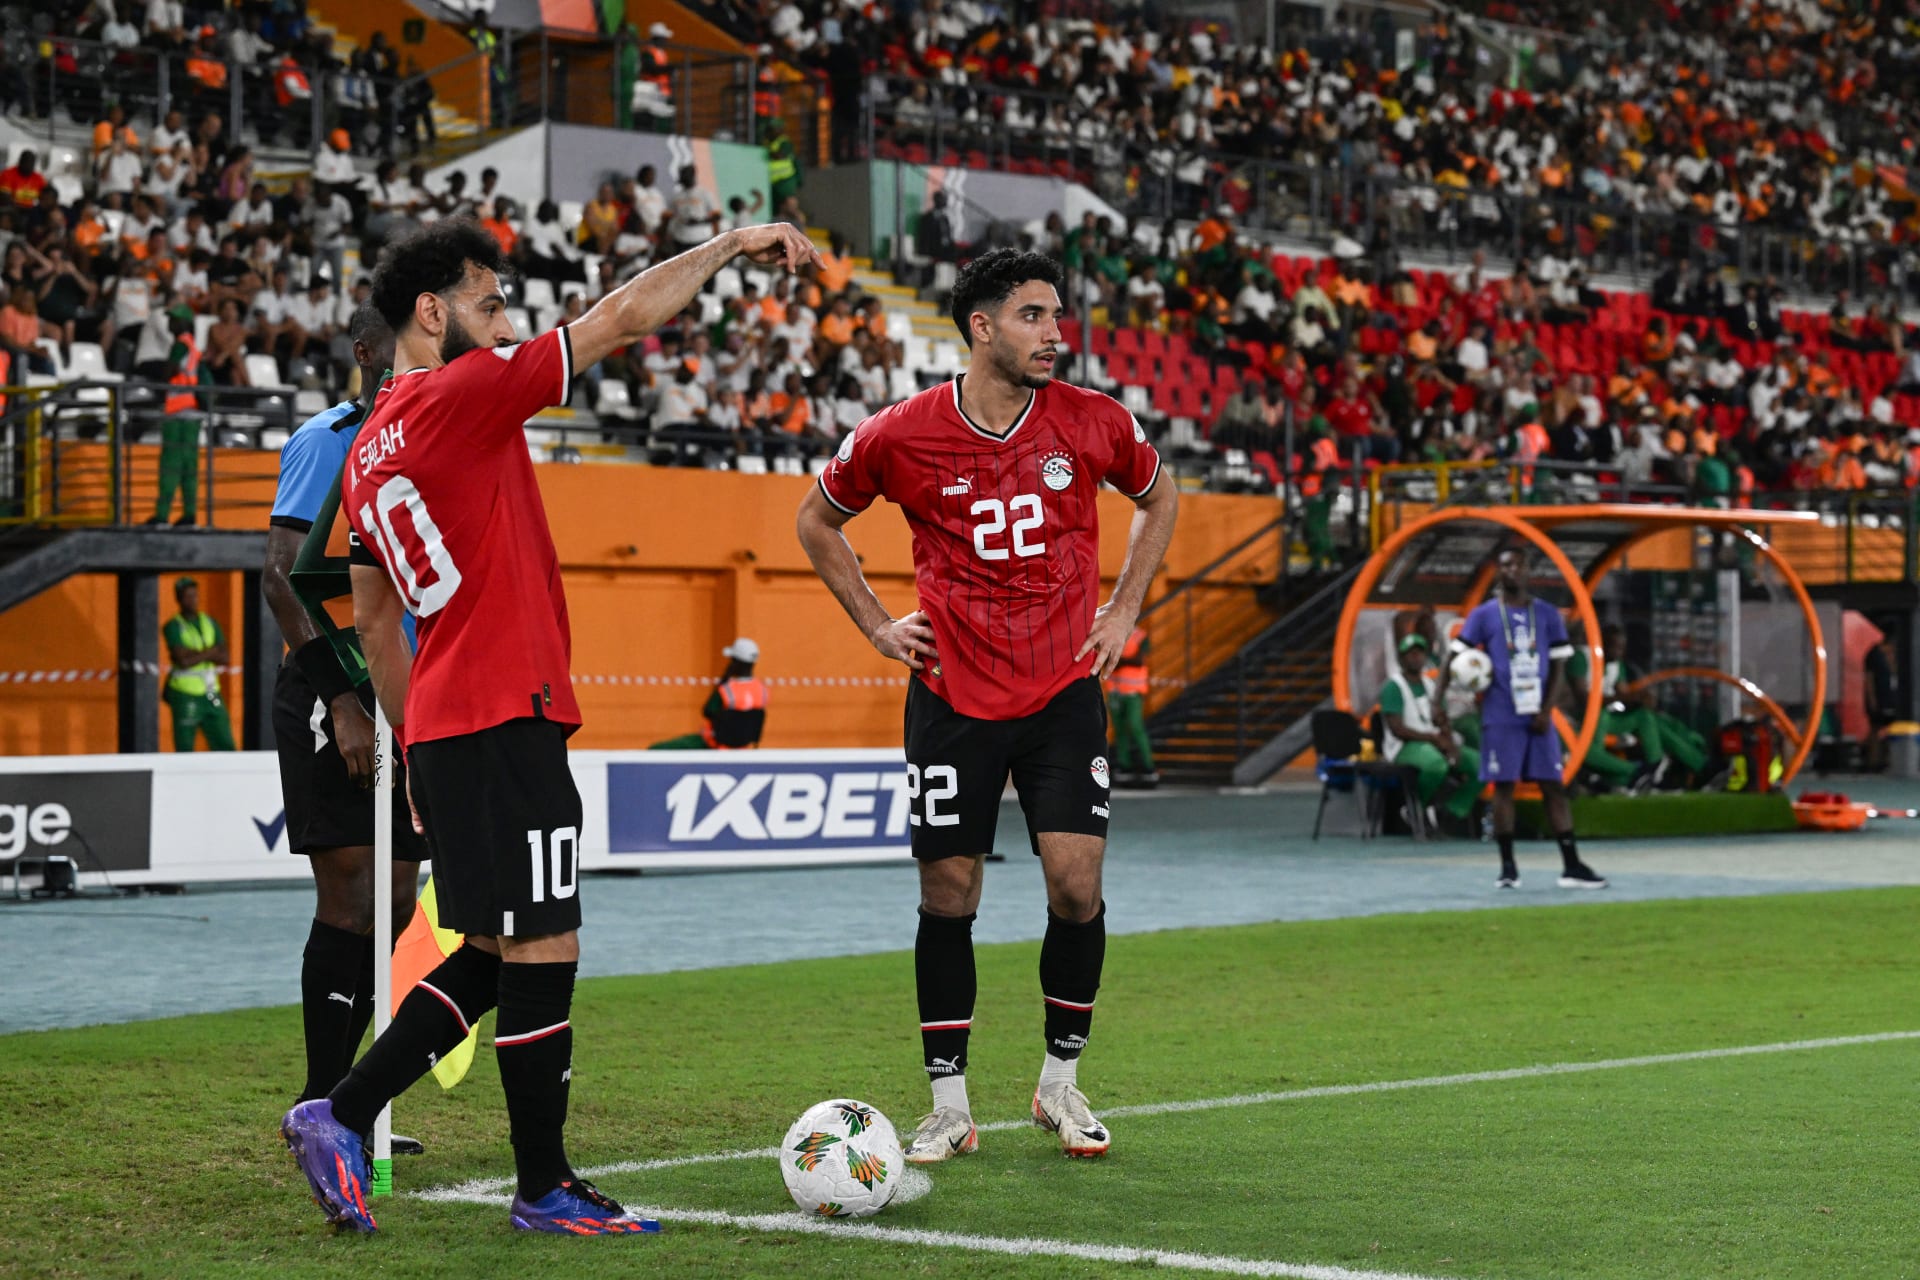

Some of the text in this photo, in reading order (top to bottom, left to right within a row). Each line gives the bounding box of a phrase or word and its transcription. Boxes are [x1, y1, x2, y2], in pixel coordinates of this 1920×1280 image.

[359, 419, 406, 477] SALAH
[942, 484, 969, 497] PUMA
[359, 474, 462, 618] 10
[970, 493, 1046, 560] 22
[666, 772, 911, 842] 1XBET
[527, 826, 578, 903] 10
